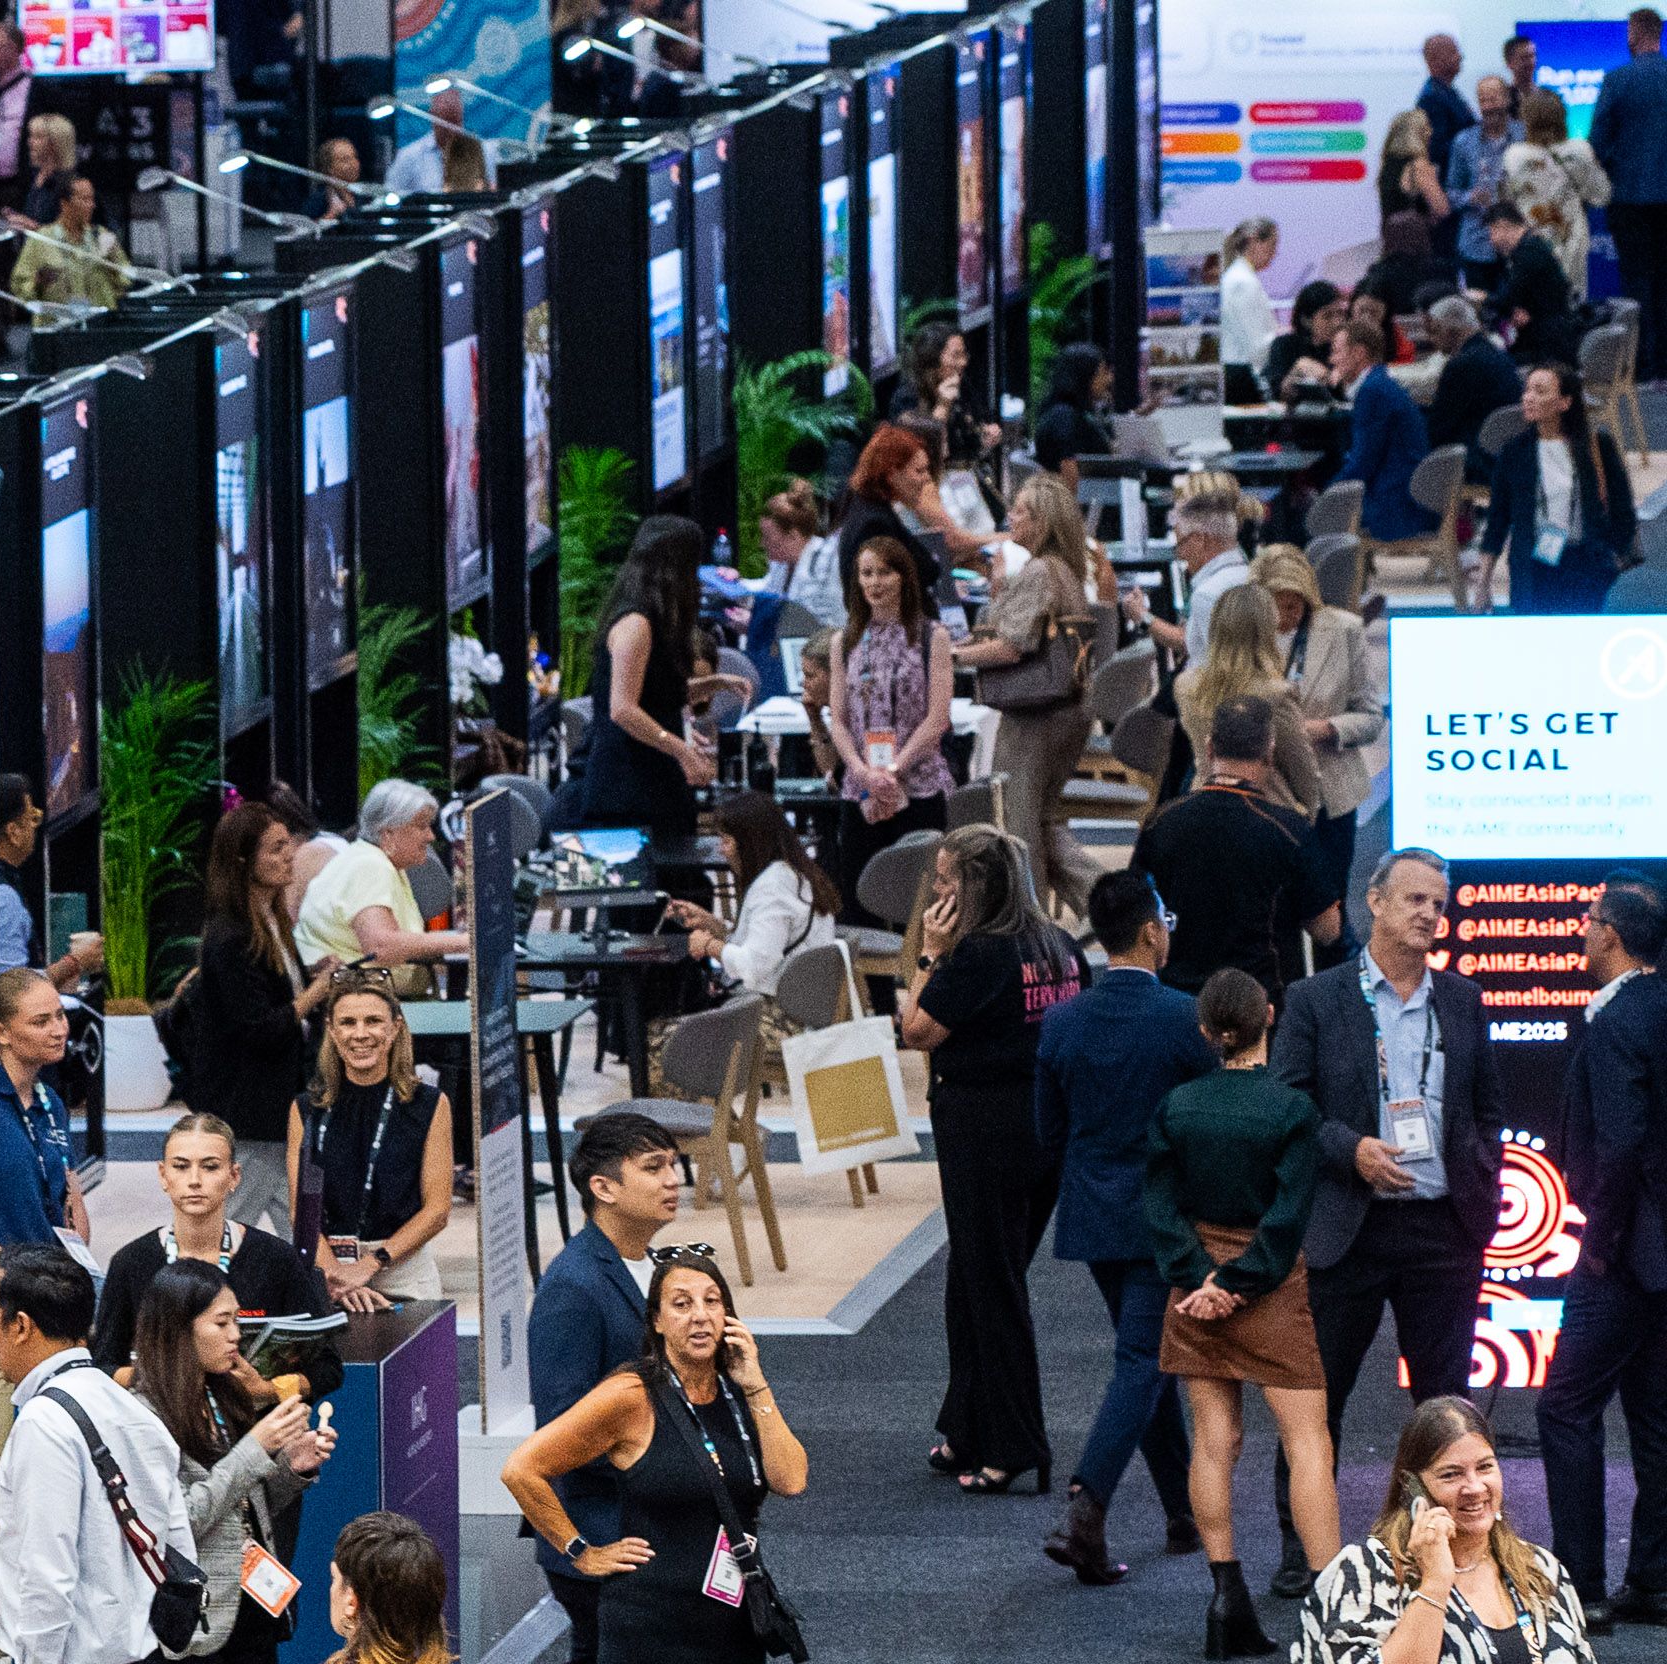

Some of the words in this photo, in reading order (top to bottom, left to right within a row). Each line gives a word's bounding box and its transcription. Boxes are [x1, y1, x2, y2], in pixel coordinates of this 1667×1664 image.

[1426, 711, 1529, 735] LET'S
[1546, 712, 1619, 735] GET
[1426, 748, 1569, 771] SOCIAL
[1425, 793, 1464, 811] Stay
[1470, 793, 1571, 809] connected
[1576, 793, 1613, 808] and
[1618, 793, 1655, 812] join
[1425, 823, 1457, 838] the
[1463, 823, 1510, 838] AIME
[1517, 822, 1627, 840] community
